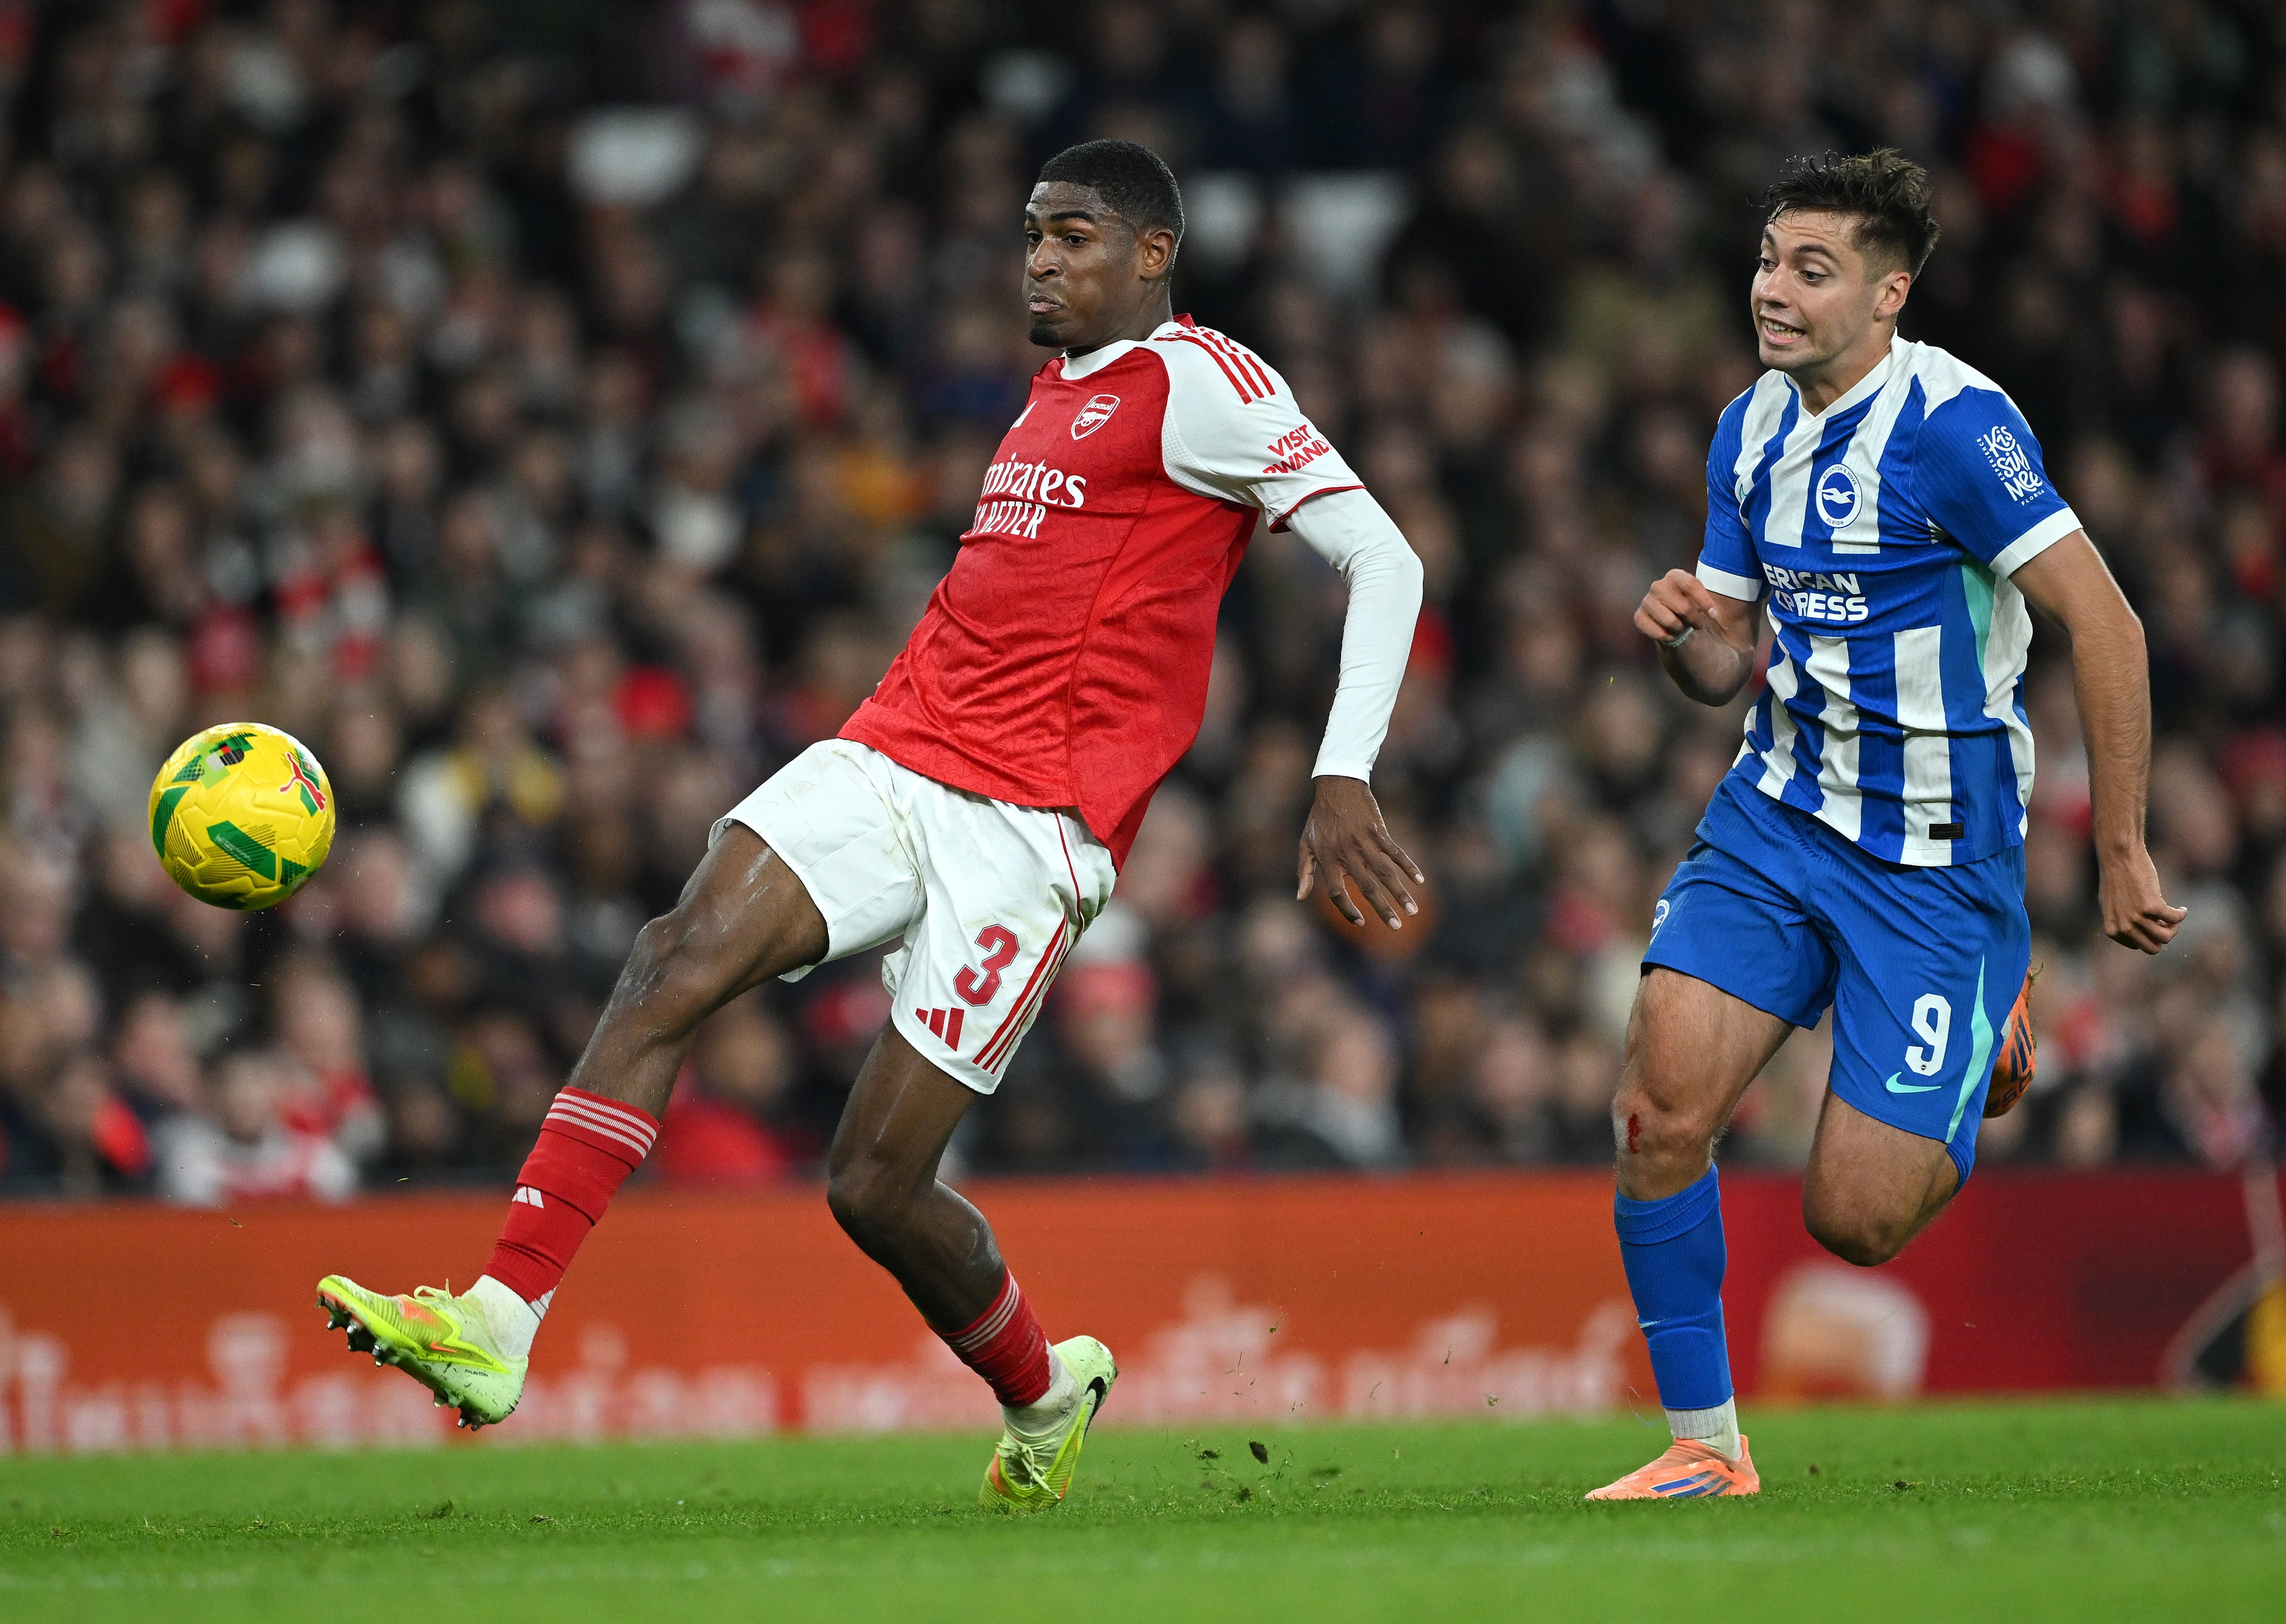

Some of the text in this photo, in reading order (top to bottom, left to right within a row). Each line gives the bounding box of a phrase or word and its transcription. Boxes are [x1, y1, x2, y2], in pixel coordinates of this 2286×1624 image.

[1088, 401, 1113, 410] Arsenal
[1263, 438, 1332, 473] WAND
[1267, 425, 1312, 456] VISIT
[1823, 466, 1843, 480] BRIGHTON
[1847, 471, 1858, 486] HOVE
[1977, 437, 2005, 481] EXPERIENCE
[980, 452, 1086, 508] mirates
[978, 501, 1046, 539] BETTER
[1762, 562, 1861, 595] ERICAN
[1775, 590, 1869, 621] PRESS
[953, 923, 1020, 1007] 3
[1905, 993, 1951, 1077] 9
